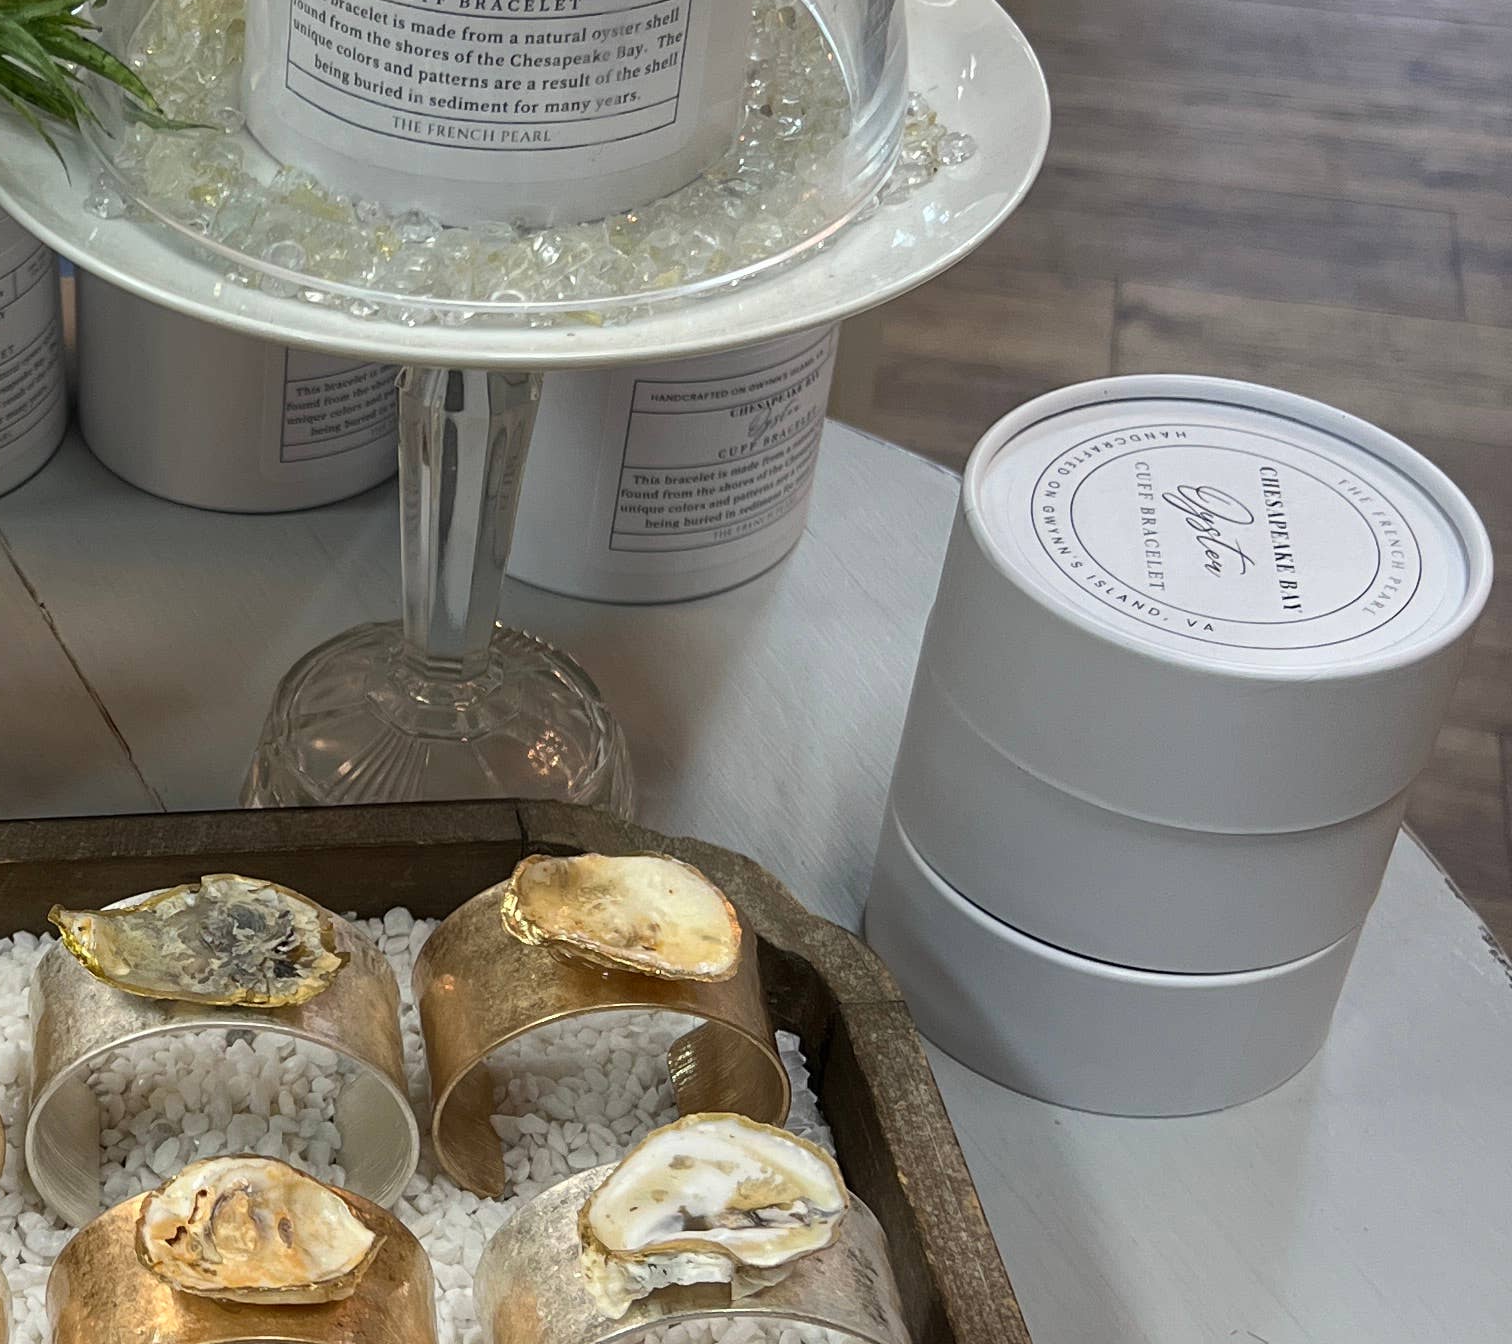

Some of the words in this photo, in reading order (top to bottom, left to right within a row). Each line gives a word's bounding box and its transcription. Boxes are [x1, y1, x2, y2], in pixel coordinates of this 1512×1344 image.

[330, 14, 362, 40] from
[367, 30, 391, 48] the
[395, 39, 449, 61] shores
[454, 49, 474, 64] of
[477, 51, 505, 67] the
[510, 49, 610, 70] Chesapeake
[616, 44, 648, 60] Bay.
[657, 32, 683, 49] The
[393, 13, 405, 29] is
[411, 22, 456, 39] made
[461, 26, 503, 44] from
[509, 34, 518, 45] a
[524, 27, 587, 45] natural
[592, 22, 642, 43] oyster
[645, 6, 680, 31] shell
[294, 19, 333, 50] unique
[336, 44, 380, 69] colors
[384, 62, 413, 78] and
[418, 69, 488, 90] patterns
[494, 79, 522, 91] are
[526, 80, 536, 90] a
[542, 73, 590, 91] result
[595, 69, 613, 86] of
[616, 66, 640, 82] the
[644, 51, 678, 75] shell
[314, 54, 350, 85] being
[354, 72, 404, 101] buried
[408, 88, 423, 105] in
[429, 91, 508, 113] sediment
[514, 99, 539, 114] for
[544, 100, 591, 114] many
[595, 91, 640, 112] years.
[392, 115, 421, 133] THE
[428, 123, 495, 142] FRENCH
[501, 130, 551, 143] PEARL
[650, 389, 729, 402] HANDCRAFTED
[1057, 430, 1187, 476] HANDCRAFTED
[620, 488, 660, 500] found
[662, 487, 693, 500] from
[633, 475, 661, 486] This
[1044, 480, 1061, 499] ON
[1134, 461, 1153, 501] CUFF
[1338, 479, 1372, 504] THE
[1043, 505, 1083, 569] GWYNN'S
[1140, 506, 1166, 591] BRACELET
[1162, 485, 1255, 578] Oyster
[1259, 466, 1296, 574] CHESAPEAKE
[1279, 579, 1303, 613] BAY
[1372, 511, 1405, 570] FRENCH
[1086, 574, 1169, 621] ISLAND,
[1362, 576, 1402, 616] PEARL
[1186, 618, 1215, 632] VA
